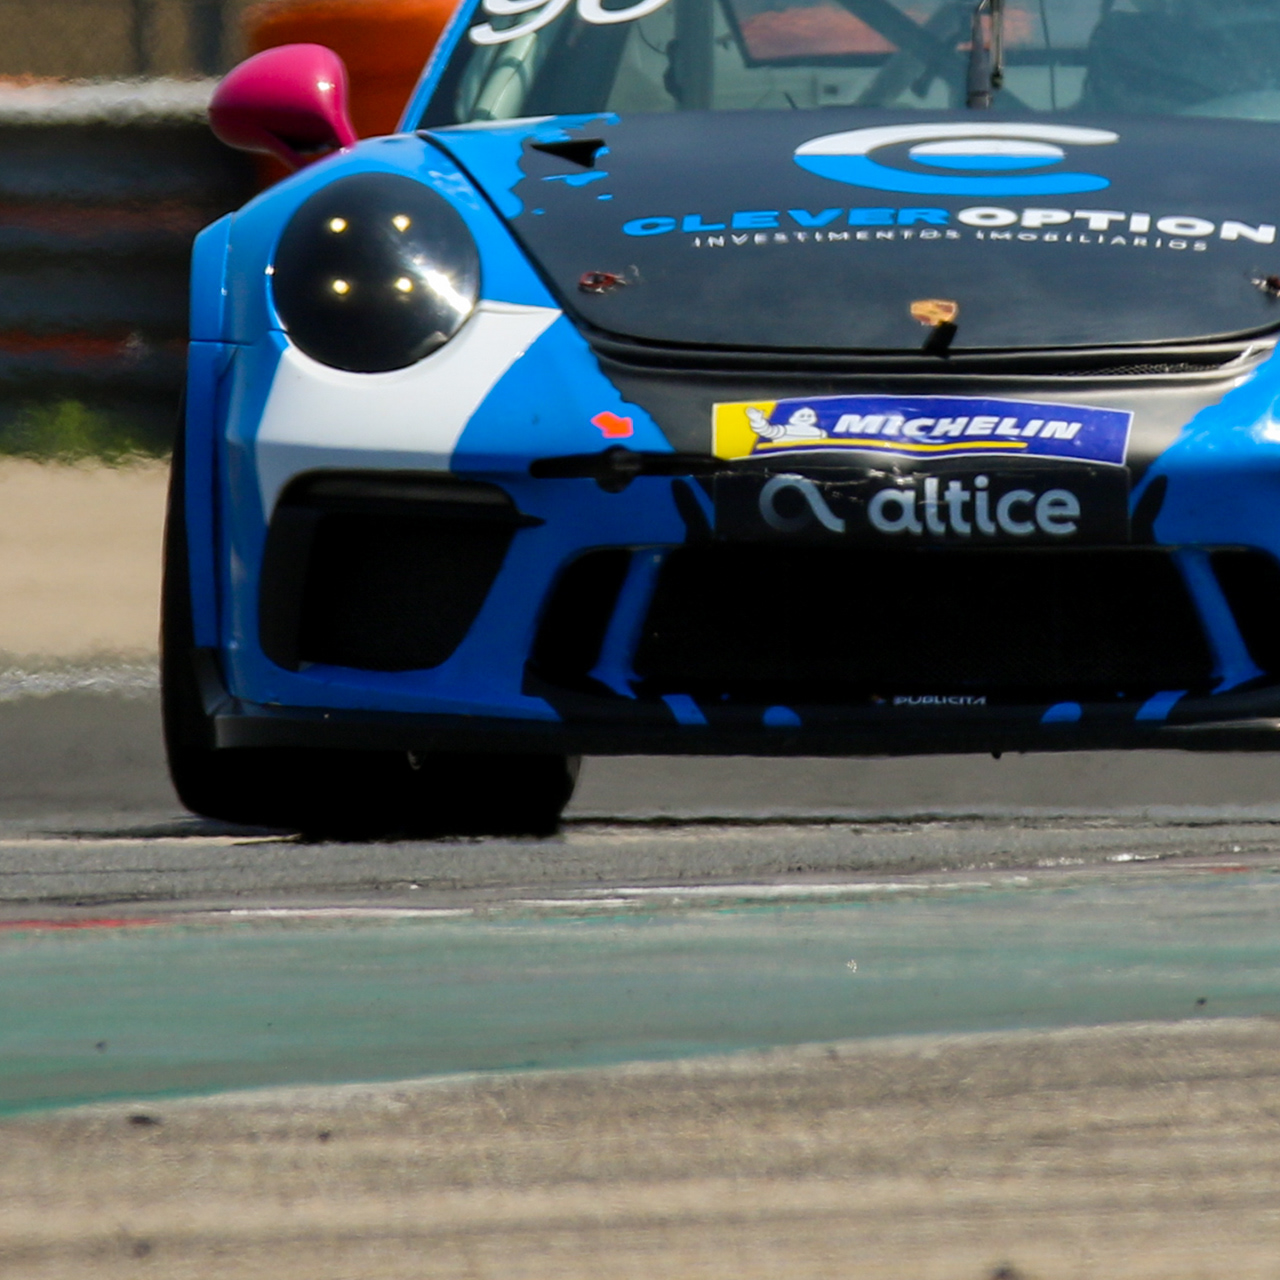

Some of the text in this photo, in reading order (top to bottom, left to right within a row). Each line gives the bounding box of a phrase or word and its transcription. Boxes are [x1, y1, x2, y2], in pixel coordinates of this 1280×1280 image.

[692, 228, 962, 248] INVESTIMENTOS
[832, 414, 1082, 442] MICHELIN
[867, 475, 1081, 536] altice
